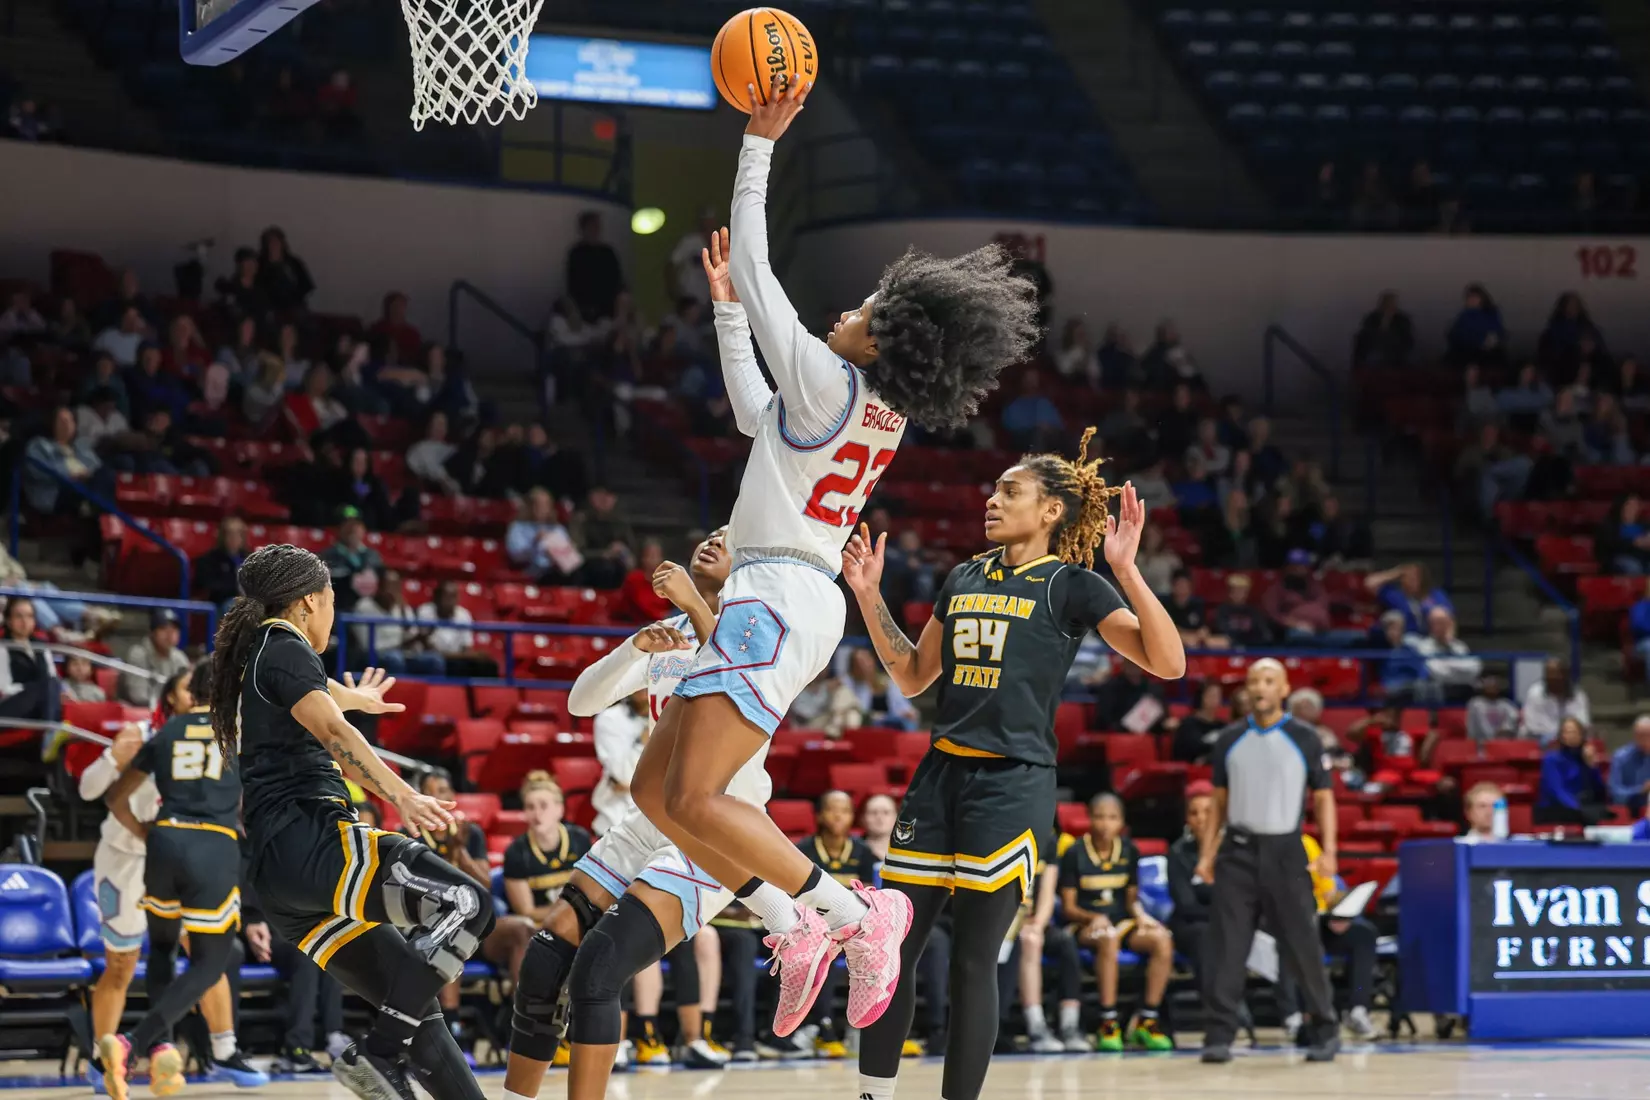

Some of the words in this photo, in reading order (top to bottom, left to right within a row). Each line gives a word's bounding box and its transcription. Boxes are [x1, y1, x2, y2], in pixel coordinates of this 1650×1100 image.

[1575, 245, 1638, 279] 102
[947, 593, 1037, 620] KENNESAW
[952, 618, 1011, 662] 24
[952, 663, 1002, 689] STATE
[171, 740, 226, 781] 21
[1492, 879, 1622, 927] Ivan
